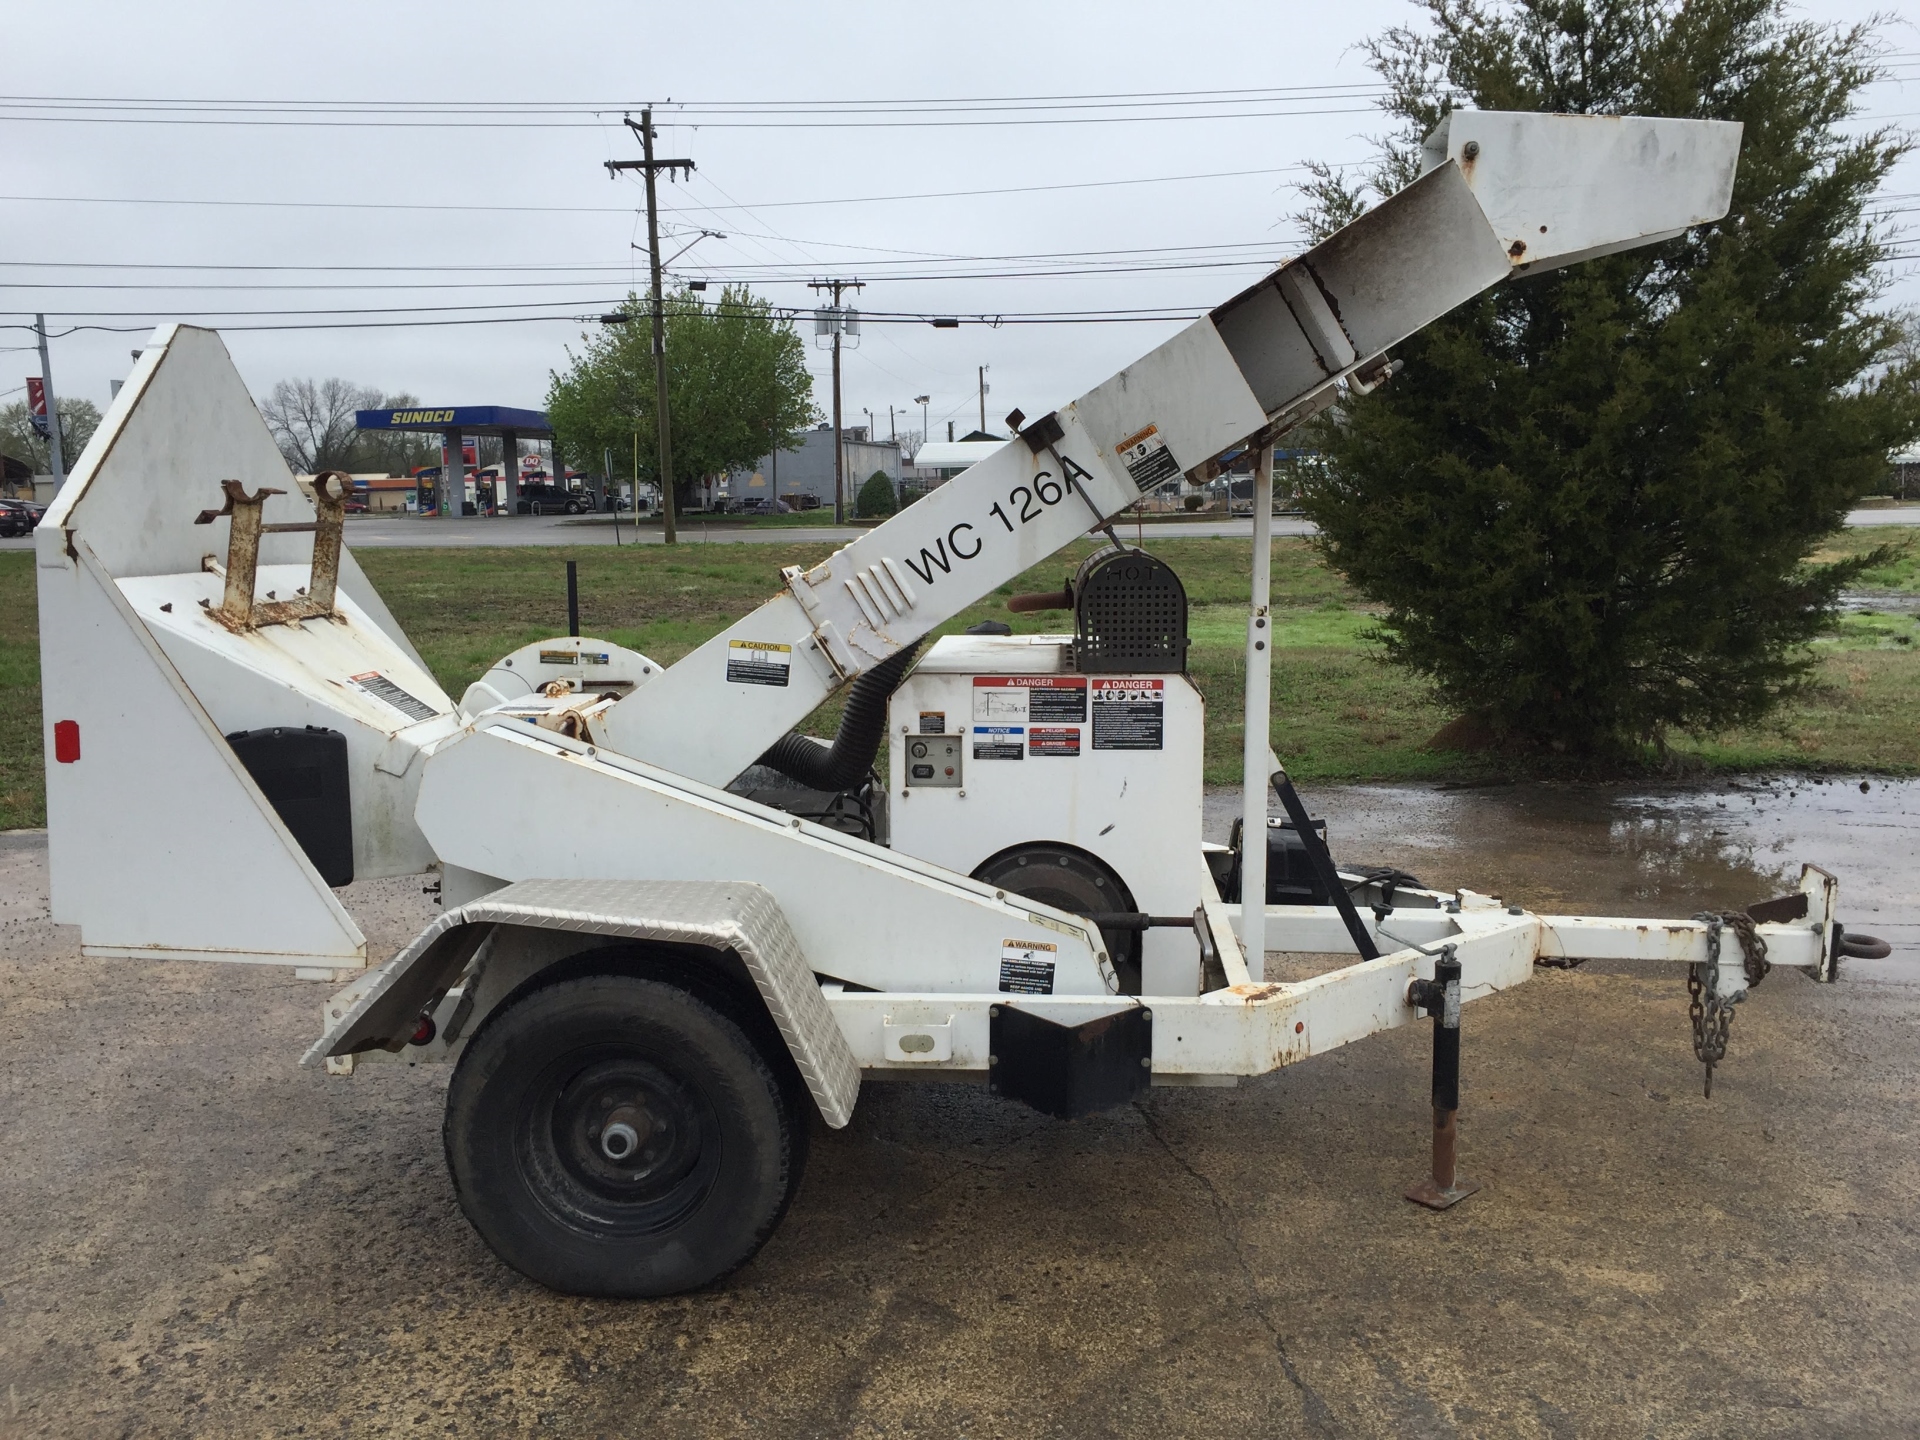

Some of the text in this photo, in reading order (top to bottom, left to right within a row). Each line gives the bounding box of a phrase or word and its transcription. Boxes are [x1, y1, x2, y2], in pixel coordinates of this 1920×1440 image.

[391, 410, 455, 424] SUNOCO
[1124, 428, 1153, 448] WARNING
[526, 457, 539, 465] DQ
[904, 522, 982, 585] WC
[989, 455, 1094, 533] 126A
[1106, 566, 1158, 580] HOT
[748, 642, 780, 651] CAUTION
[1016, 678, 1054, 686] DANGER
[1112, 681, 1153, 689] DANGER
[1015, 941, 1051, 951] WARNING
